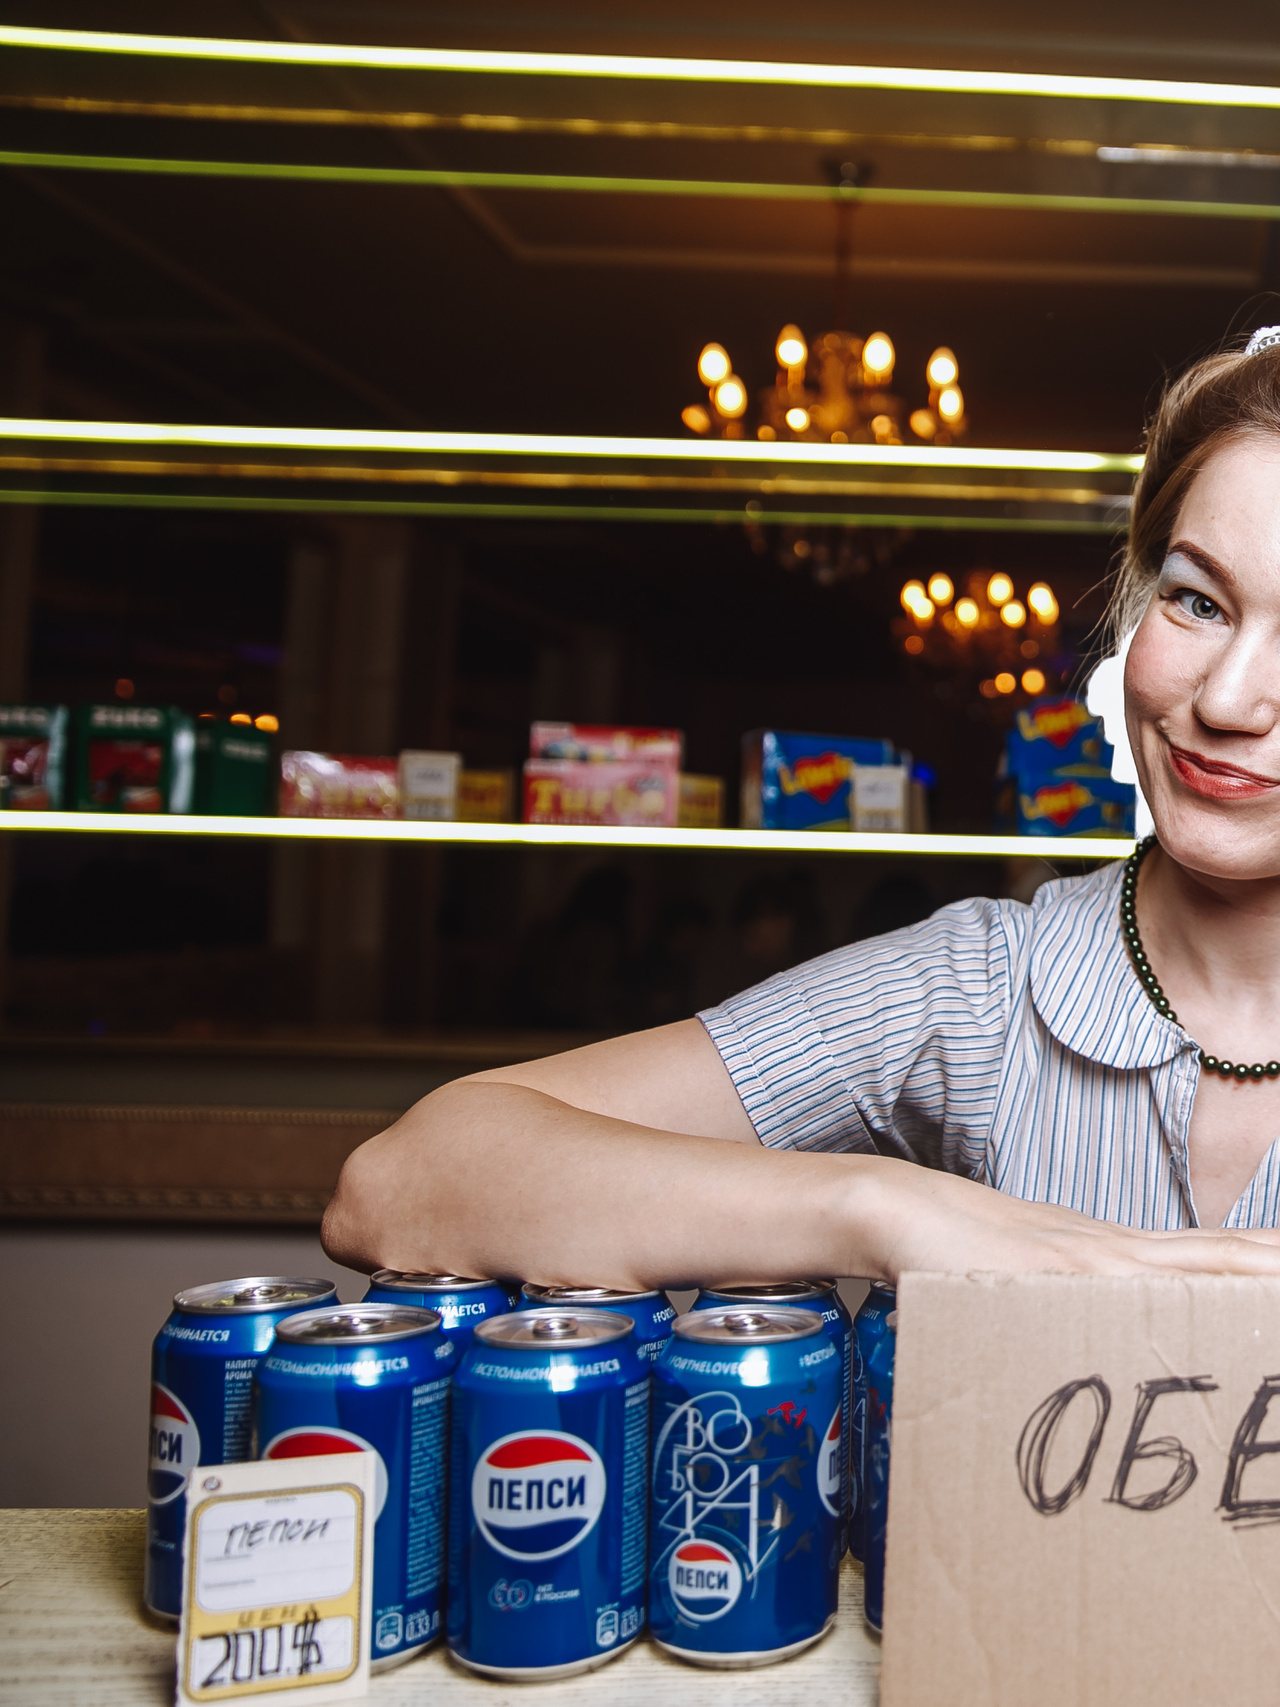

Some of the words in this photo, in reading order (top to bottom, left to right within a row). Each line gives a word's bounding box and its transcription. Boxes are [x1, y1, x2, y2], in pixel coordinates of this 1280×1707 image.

[488, 1474, 586, 1511] ПЕПСИ
[224, 1518, 331, 1555] ПЕПСИ
[675, 1564, 729, 1590] ПЕПСИ
